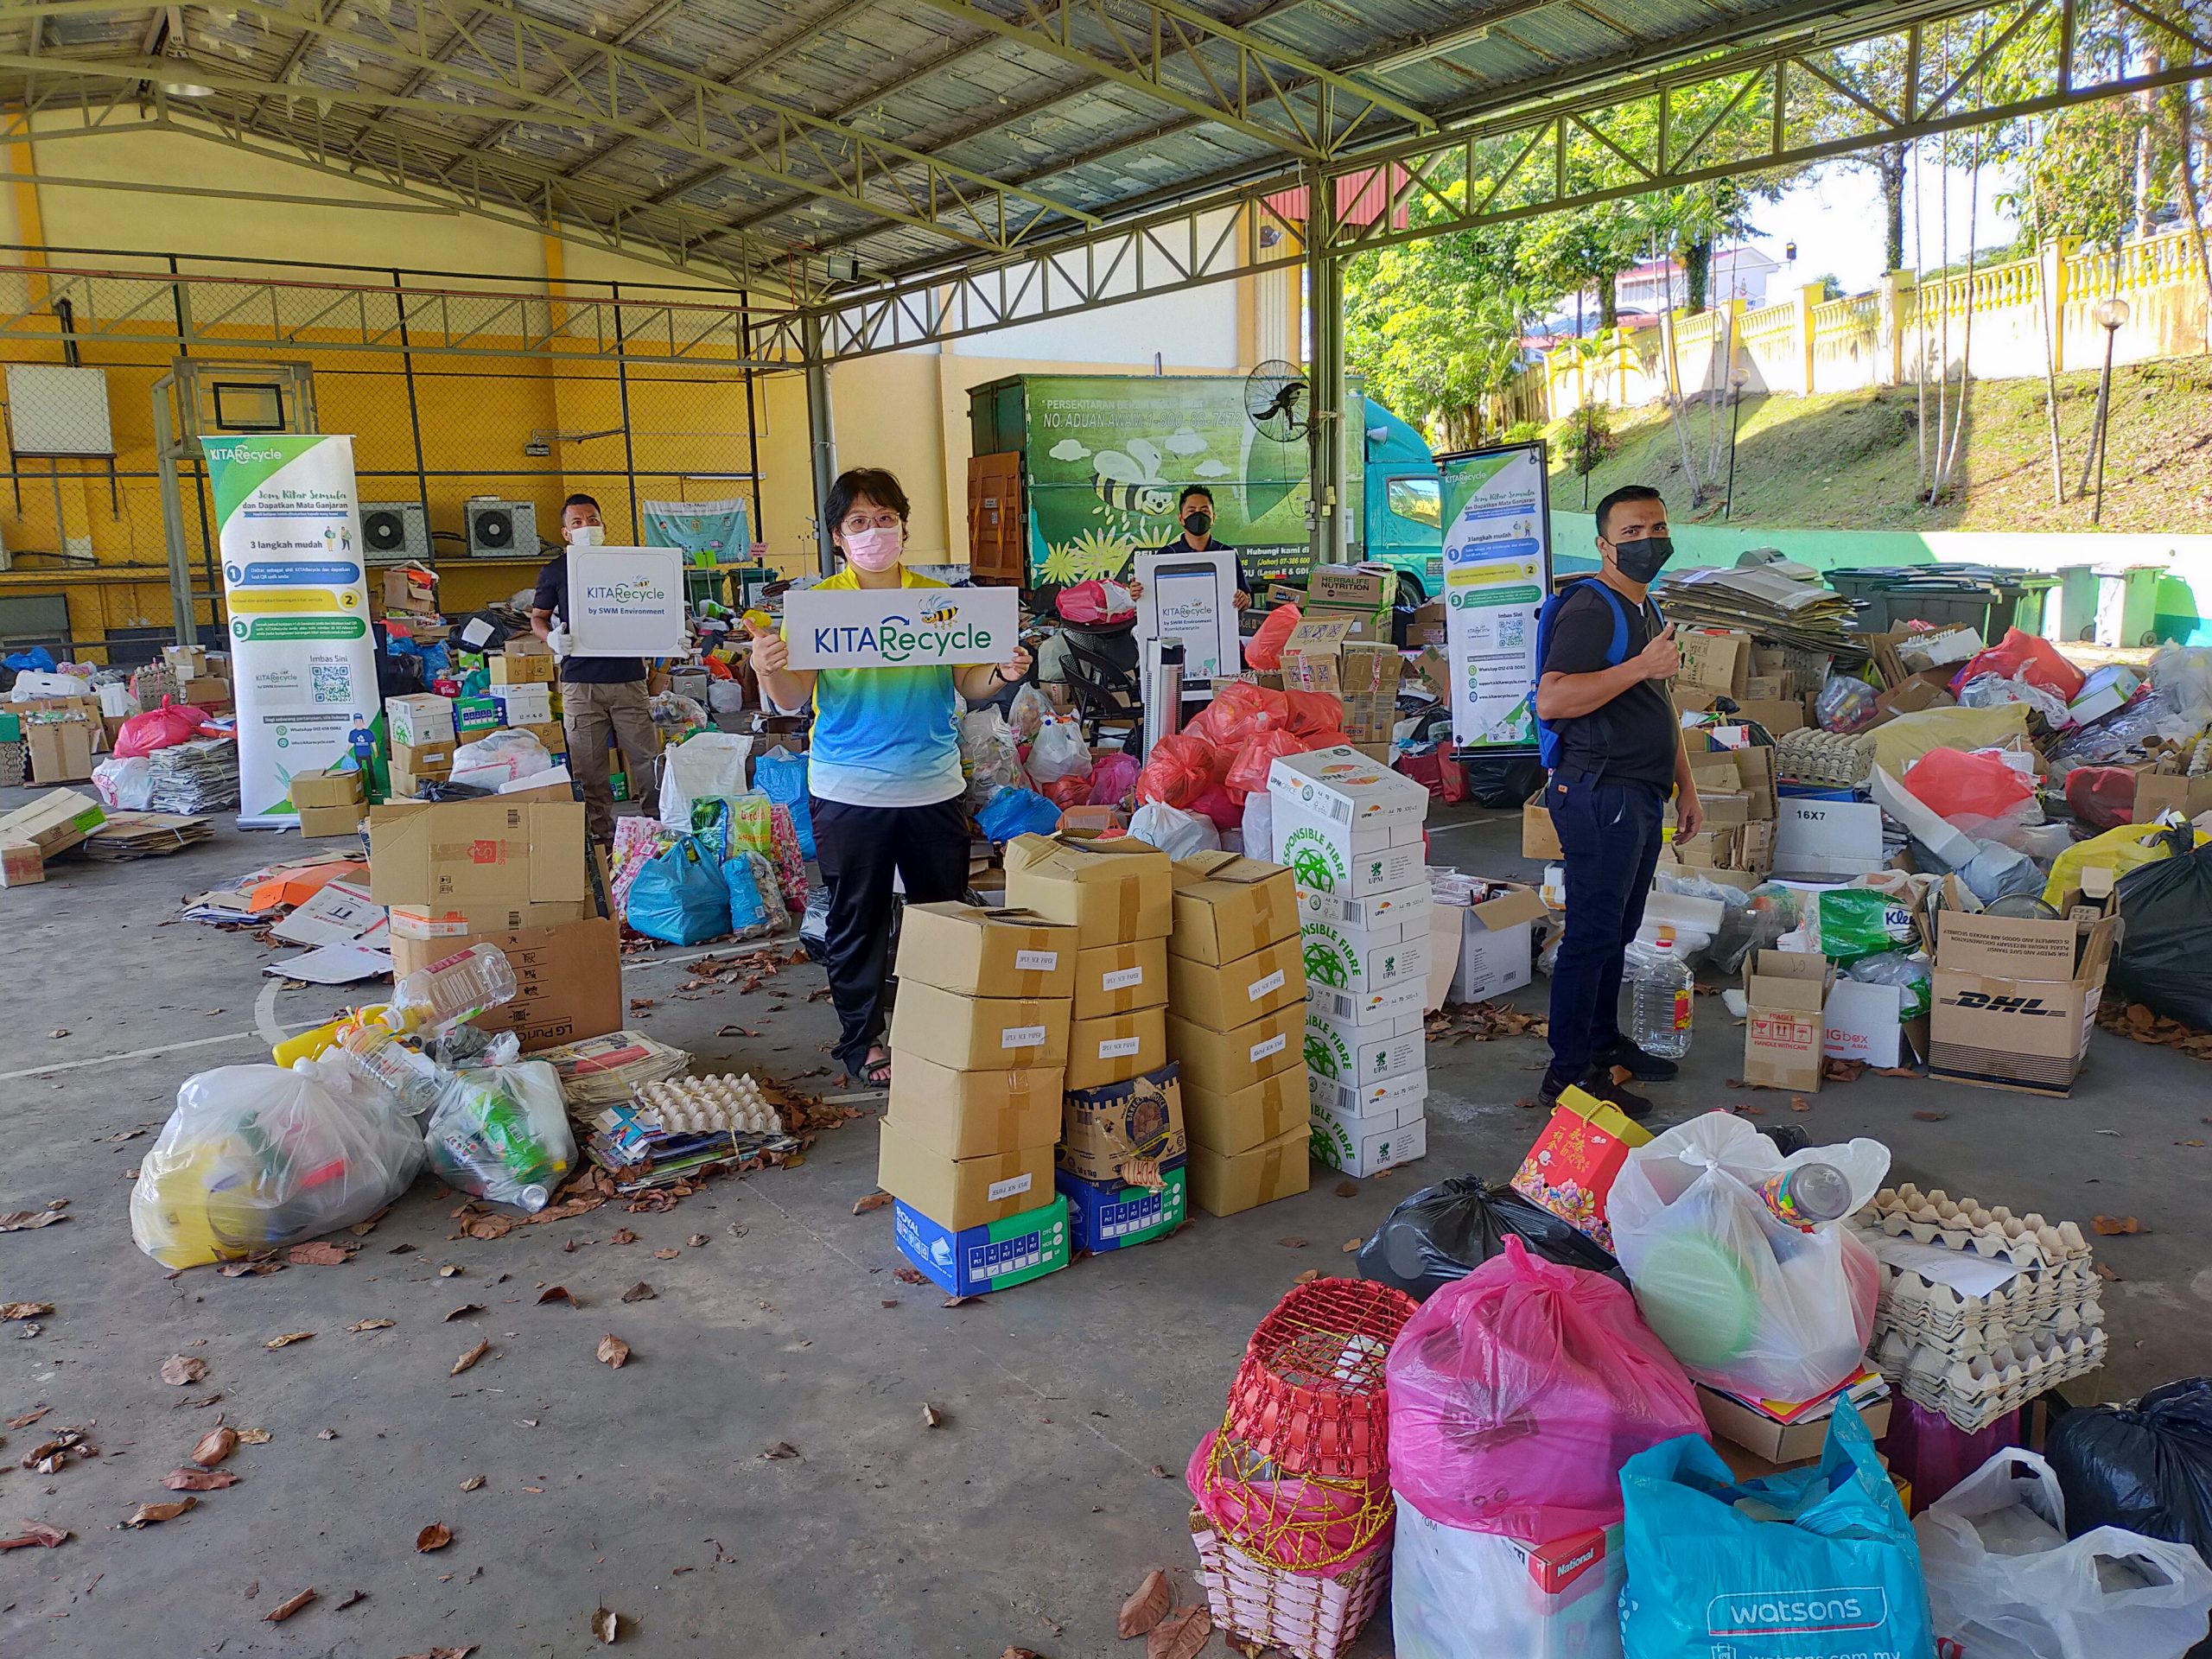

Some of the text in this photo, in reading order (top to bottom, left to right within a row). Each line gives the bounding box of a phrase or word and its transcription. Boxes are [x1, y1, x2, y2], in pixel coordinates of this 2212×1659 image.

[1044, 413, 1107, 428] NO. ADUAN
[209, 448, 282, 463] KITARecycle
[1445, 471, 1486, 485] KITARecycle
[283, 490, 307, 499] Kitar
[310, 490, 346, 499] Semula
[258, 502, 294, 511] Dapatkan
[315, 502, 348, 511] Ganjaran
[1471, 534, 1492, 543] langkah
[258, 541, 293, 552] langkah
[295, 540, 323, 549] mudah
[1246, 548, 1280, 557] Hubungi
[1301, 546, 1310, 555] di
[1256, 558, 1279, 567] (Johor)
[230, 569, 236, 579] 1
[1282, 567, 1287, 576] E
[1288, 567, 1294, 575] &
[1528, 566, 1534, 575] 2
[1321, 576, 1370, 585] HERBALIFE
[1321, 582, 1370, 591] NUTRITION
[587, 585, 664, 602] KITARecycle
[345, 595, 353, 605] 2
[1162, 606, 1212, 617] KITARecycle
[236, 623, 243, 634] 3
[815, 620, 991, 659] KITARecycle
[334, 654, 348, 663] Sini
[1270, 776, 1282, 787] UPM
[1796, 810, 1826, 821] 16X7
[1282, 827, 1325, 866] ESPONSIBLE
[1325, 841, 1347, 880] FIBRE
[1368, 875, 1383, 885] UPM
[1951, 936, 1996, 946] DOCUMENTATION
[1997, 940, 2027, 949] NECESSARY
[1040, 956, 1053, 964] PAPER
[1338, 938, 1362, 976] FIBRE
[1382, 970, 1396, 980] UPM
[1955, 990, 2050, 1016] DHL
[1769, 1013, 1795, 1021] FRAGILE
[556, 1023, 574, 1036] LG
[1754, 1039, 1777, 1048] HANDLE
[1329, 1031, 1353, 1071] FIBRE
[1373, 1065, 1389, 1075] UPM
[1332, 1122, 1356, 1160] FIBRE
[1376, 1155, 1390, 1165] UPM
[895, 1205, 920, 1237] ROYAL
[1557, 1548, 1594, 1578] National
[1730, 1598, 1862, 1625] watsons
